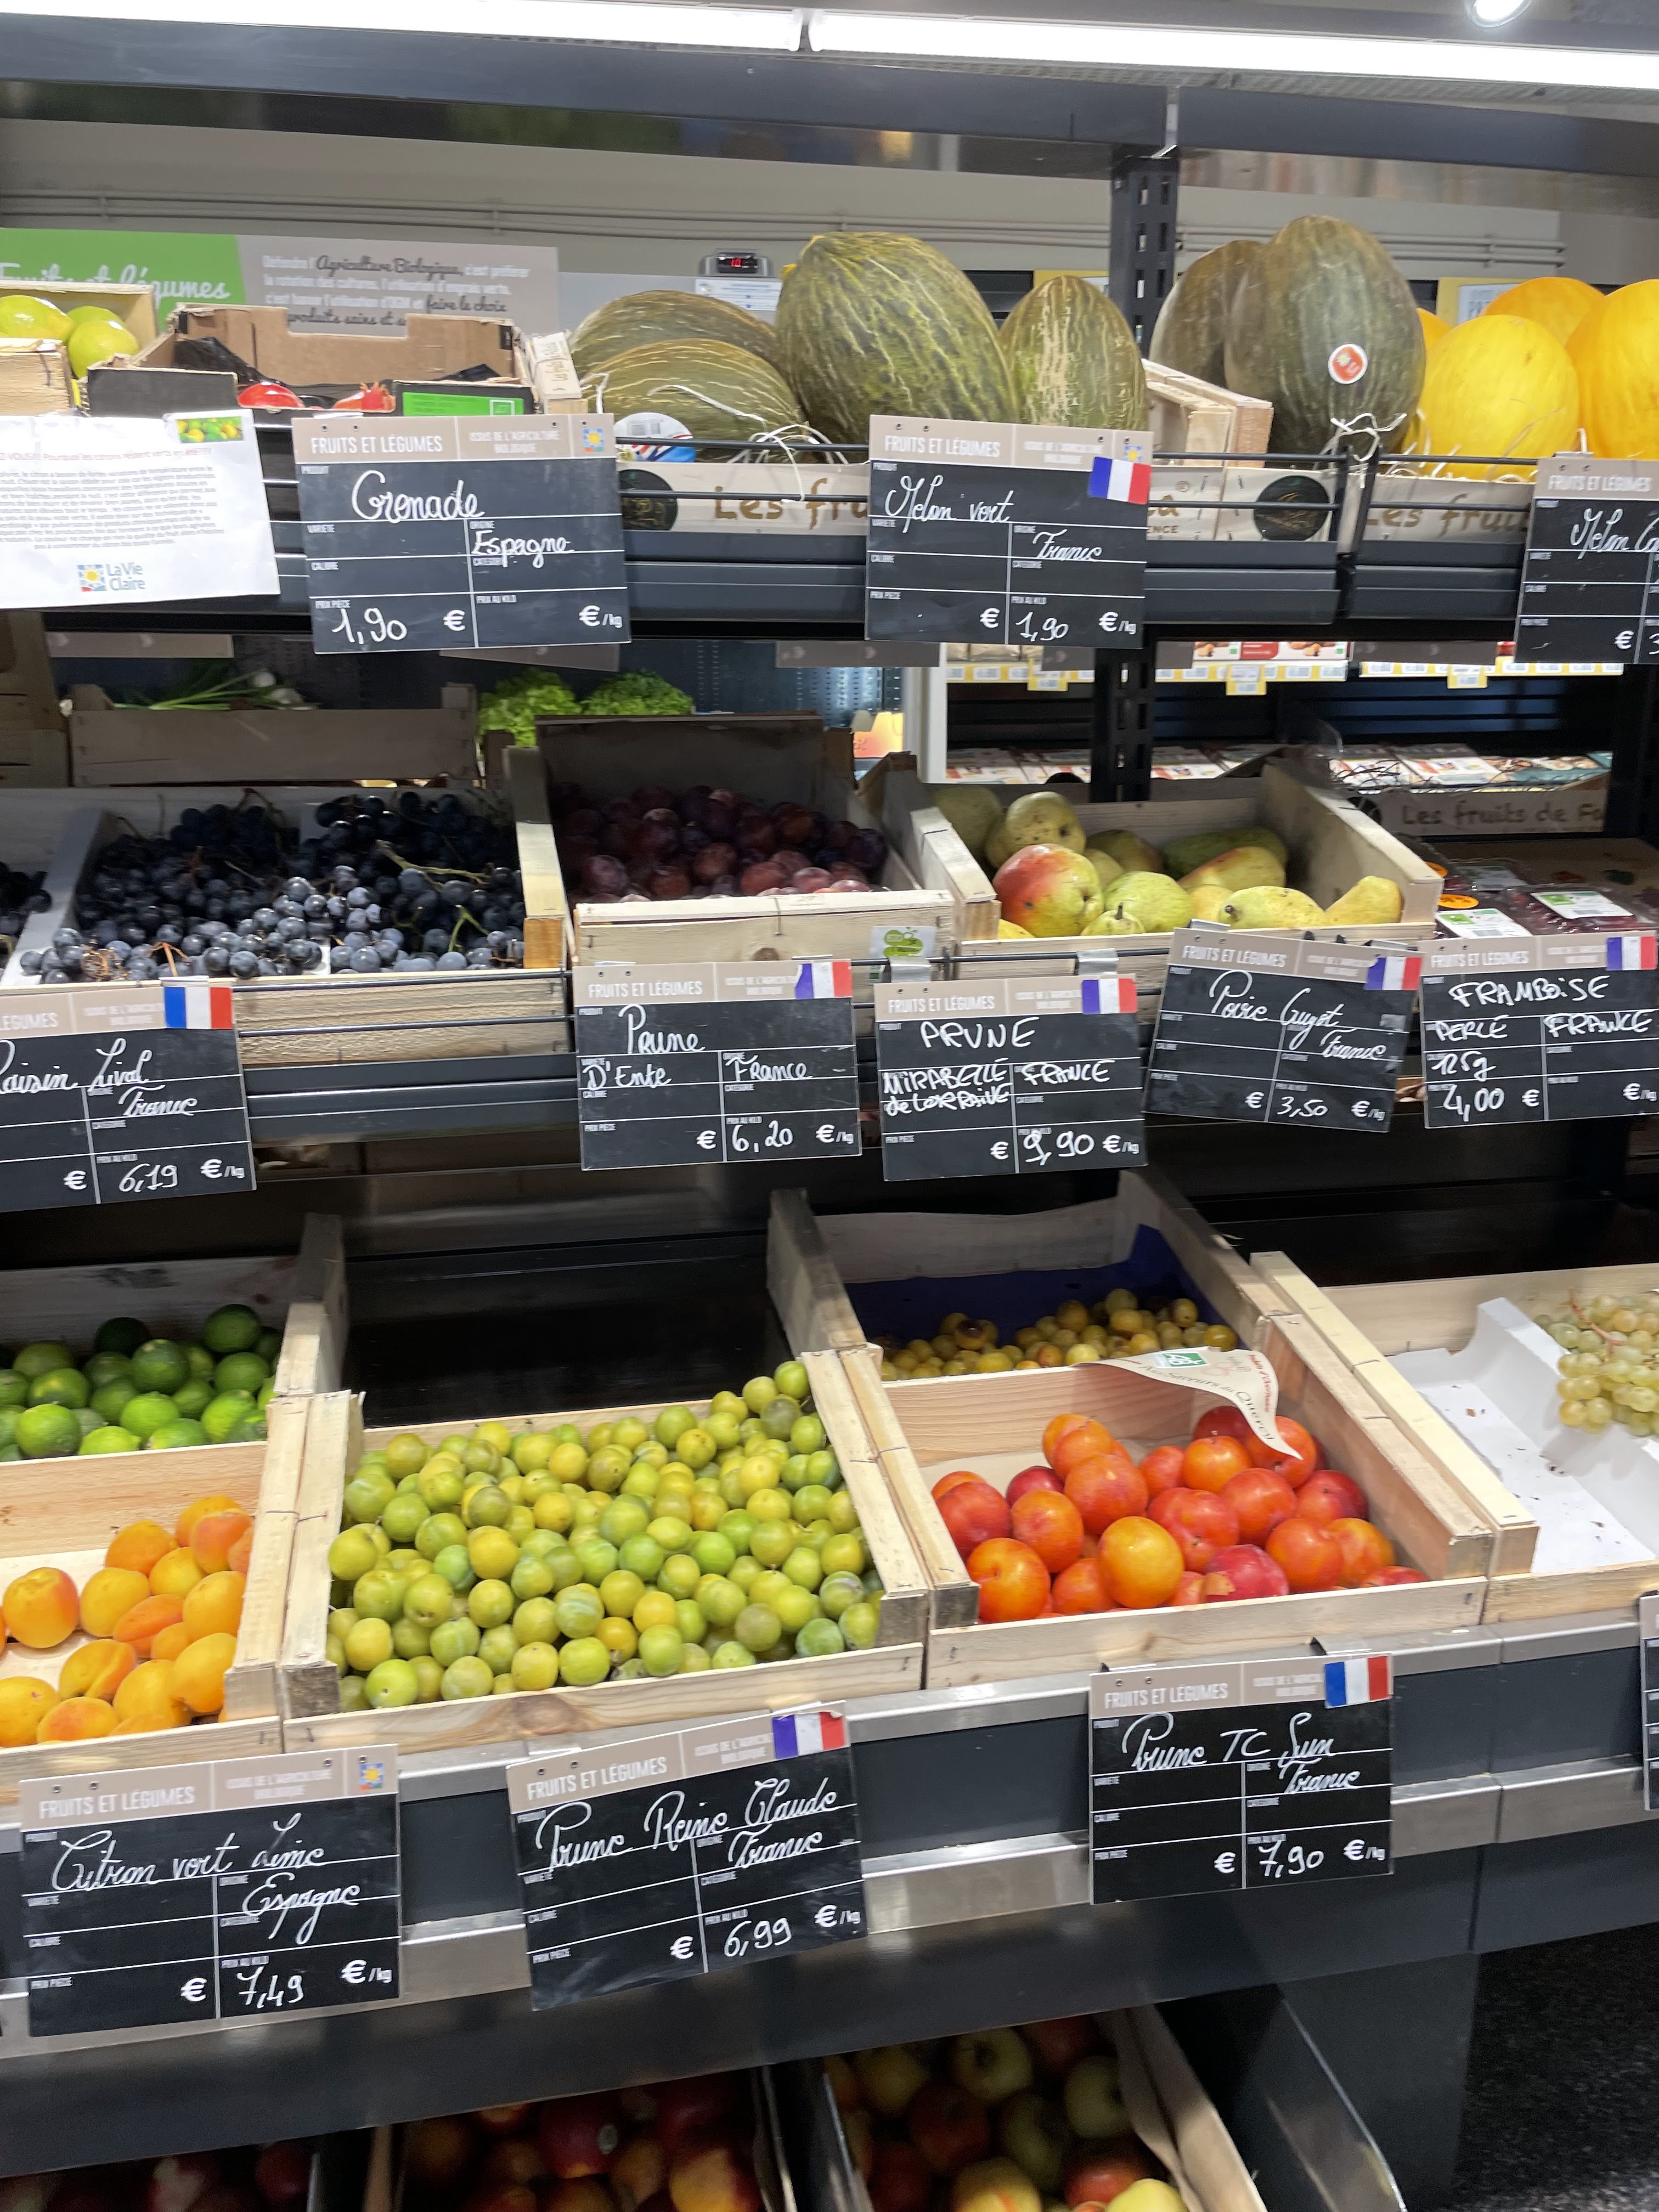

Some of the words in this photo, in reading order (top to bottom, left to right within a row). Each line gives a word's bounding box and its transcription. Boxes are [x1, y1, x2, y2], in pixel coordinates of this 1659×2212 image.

[311, 437, 357, 454] FRUITS
[361, 437, 376, 453] ET
[381, 435, 443, 453] LÉGUMES
[884, 435, 926, 454] FRUITS
[929, 438, 941, 454] ET
[351, 470, 485, 523] Grenade
[714, 486, 783, 520] Les
[471, 530, 575, 568] Espagne
[121, 562, 143, 576] Vie
[109, 577, 145, 591] Claire
[331, 607, 407, 644] 1,90
[443, 610, 466, 631] €
[980, 607, 1000, 628] €
[1015, 611, 1069, 642] 1,90
[1614, 630, 1634, 650] €
[1402, 805, 1449, 825] Les
[588, 983, 629, 998] FRUITS
[632, 983, 645, 996] ET
[888, 998, 926, 1013] FRUITS
[929, 997, 941, 1012] ET
[919, 1017, 1040, 1049] PRUNE
[1543, 1009, 1655, 1037] FRANCE
[583, 1060, 672, 1091] D'Ente
[725, 1055, 813, 1082] France
[1022, 1059, 1115, 1085] FRANCE
[1245, 1092, 1264, 1109] €
[1277, 1096, 1328, 1118] 3,50
[1442, 1084, 1505, 1122] 4,00
[1521, 1089, 1540, 1107] €
[696, 1130, 716, 1149] €
[732, 1120, 793, 1153] 6,20
[1023, 1130, 1096, 1166] 9,90
[990, 1142, 1009, 1159] €
[64, 1170, 87, 1190] €
[119, 1163, 178, 1192] 6,19
[1104, 1691, 1149, 1709] FRUITS
[1152, 1689, 1166, 1706] ET
[1220, 1728, 1271, 1761] TC
[526, 1777, 578, 1800] FRUITS
[581, 1771, 597, 1791] ET
[39, 1795, 93, 1819] FRUITS
[98, 1794, 116, 1813] ET
[644, 1790, 729, 1851] Reine
[745, 1777, 838, 1825] Claude
[1214, 1852, 1235, 1873] €
[1259, 1841, 1324, 1878] 7,90
[670, 1936, 695, 1959] €
[725, 1917, 792, 1957] 6,99
[180, 1977, 207, 2002] €
[237, 1967, 304, 2008] 7,49
[341, 1960, 392, 1984] €/kg
